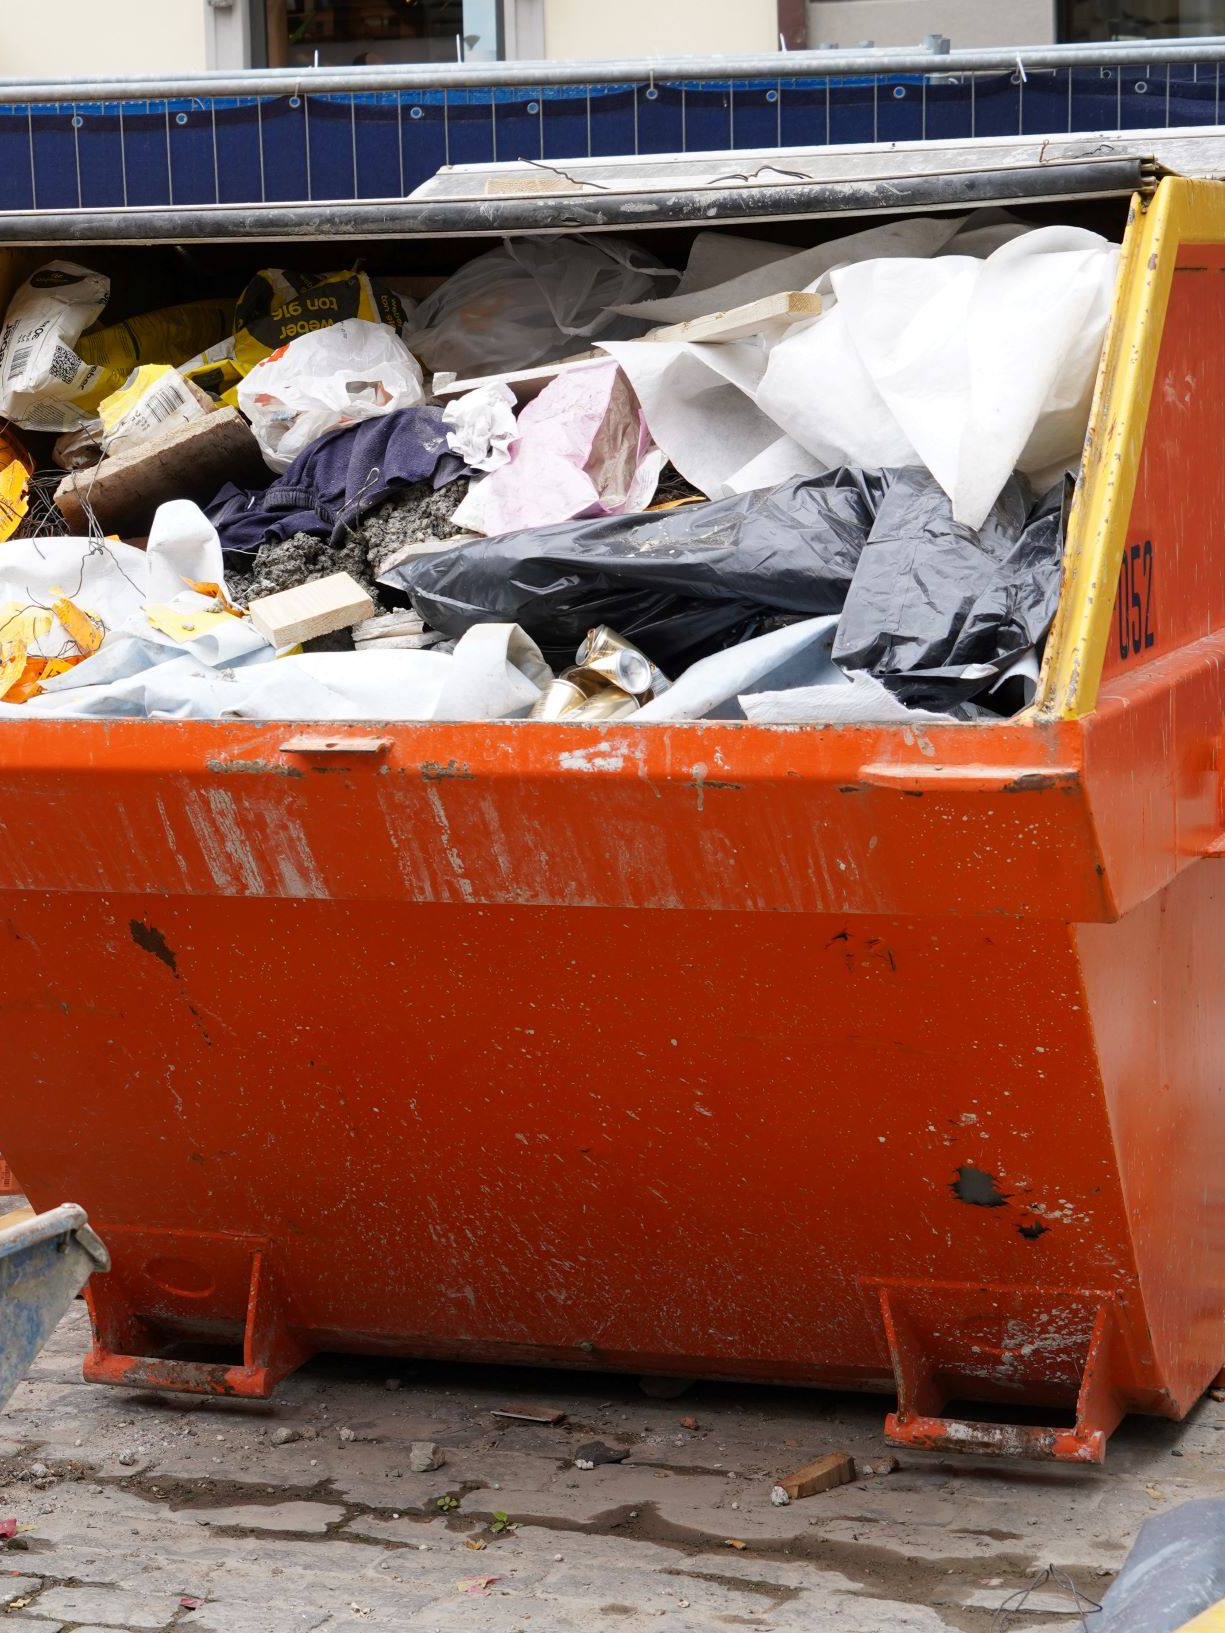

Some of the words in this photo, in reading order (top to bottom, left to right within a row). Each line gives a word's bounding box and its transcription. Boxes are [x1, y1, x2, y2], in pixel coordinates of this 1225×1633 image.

[307, 295, 339, 310] ton
[279, 318, 335, 340] weber
[80, 366, 99, 391] eber
